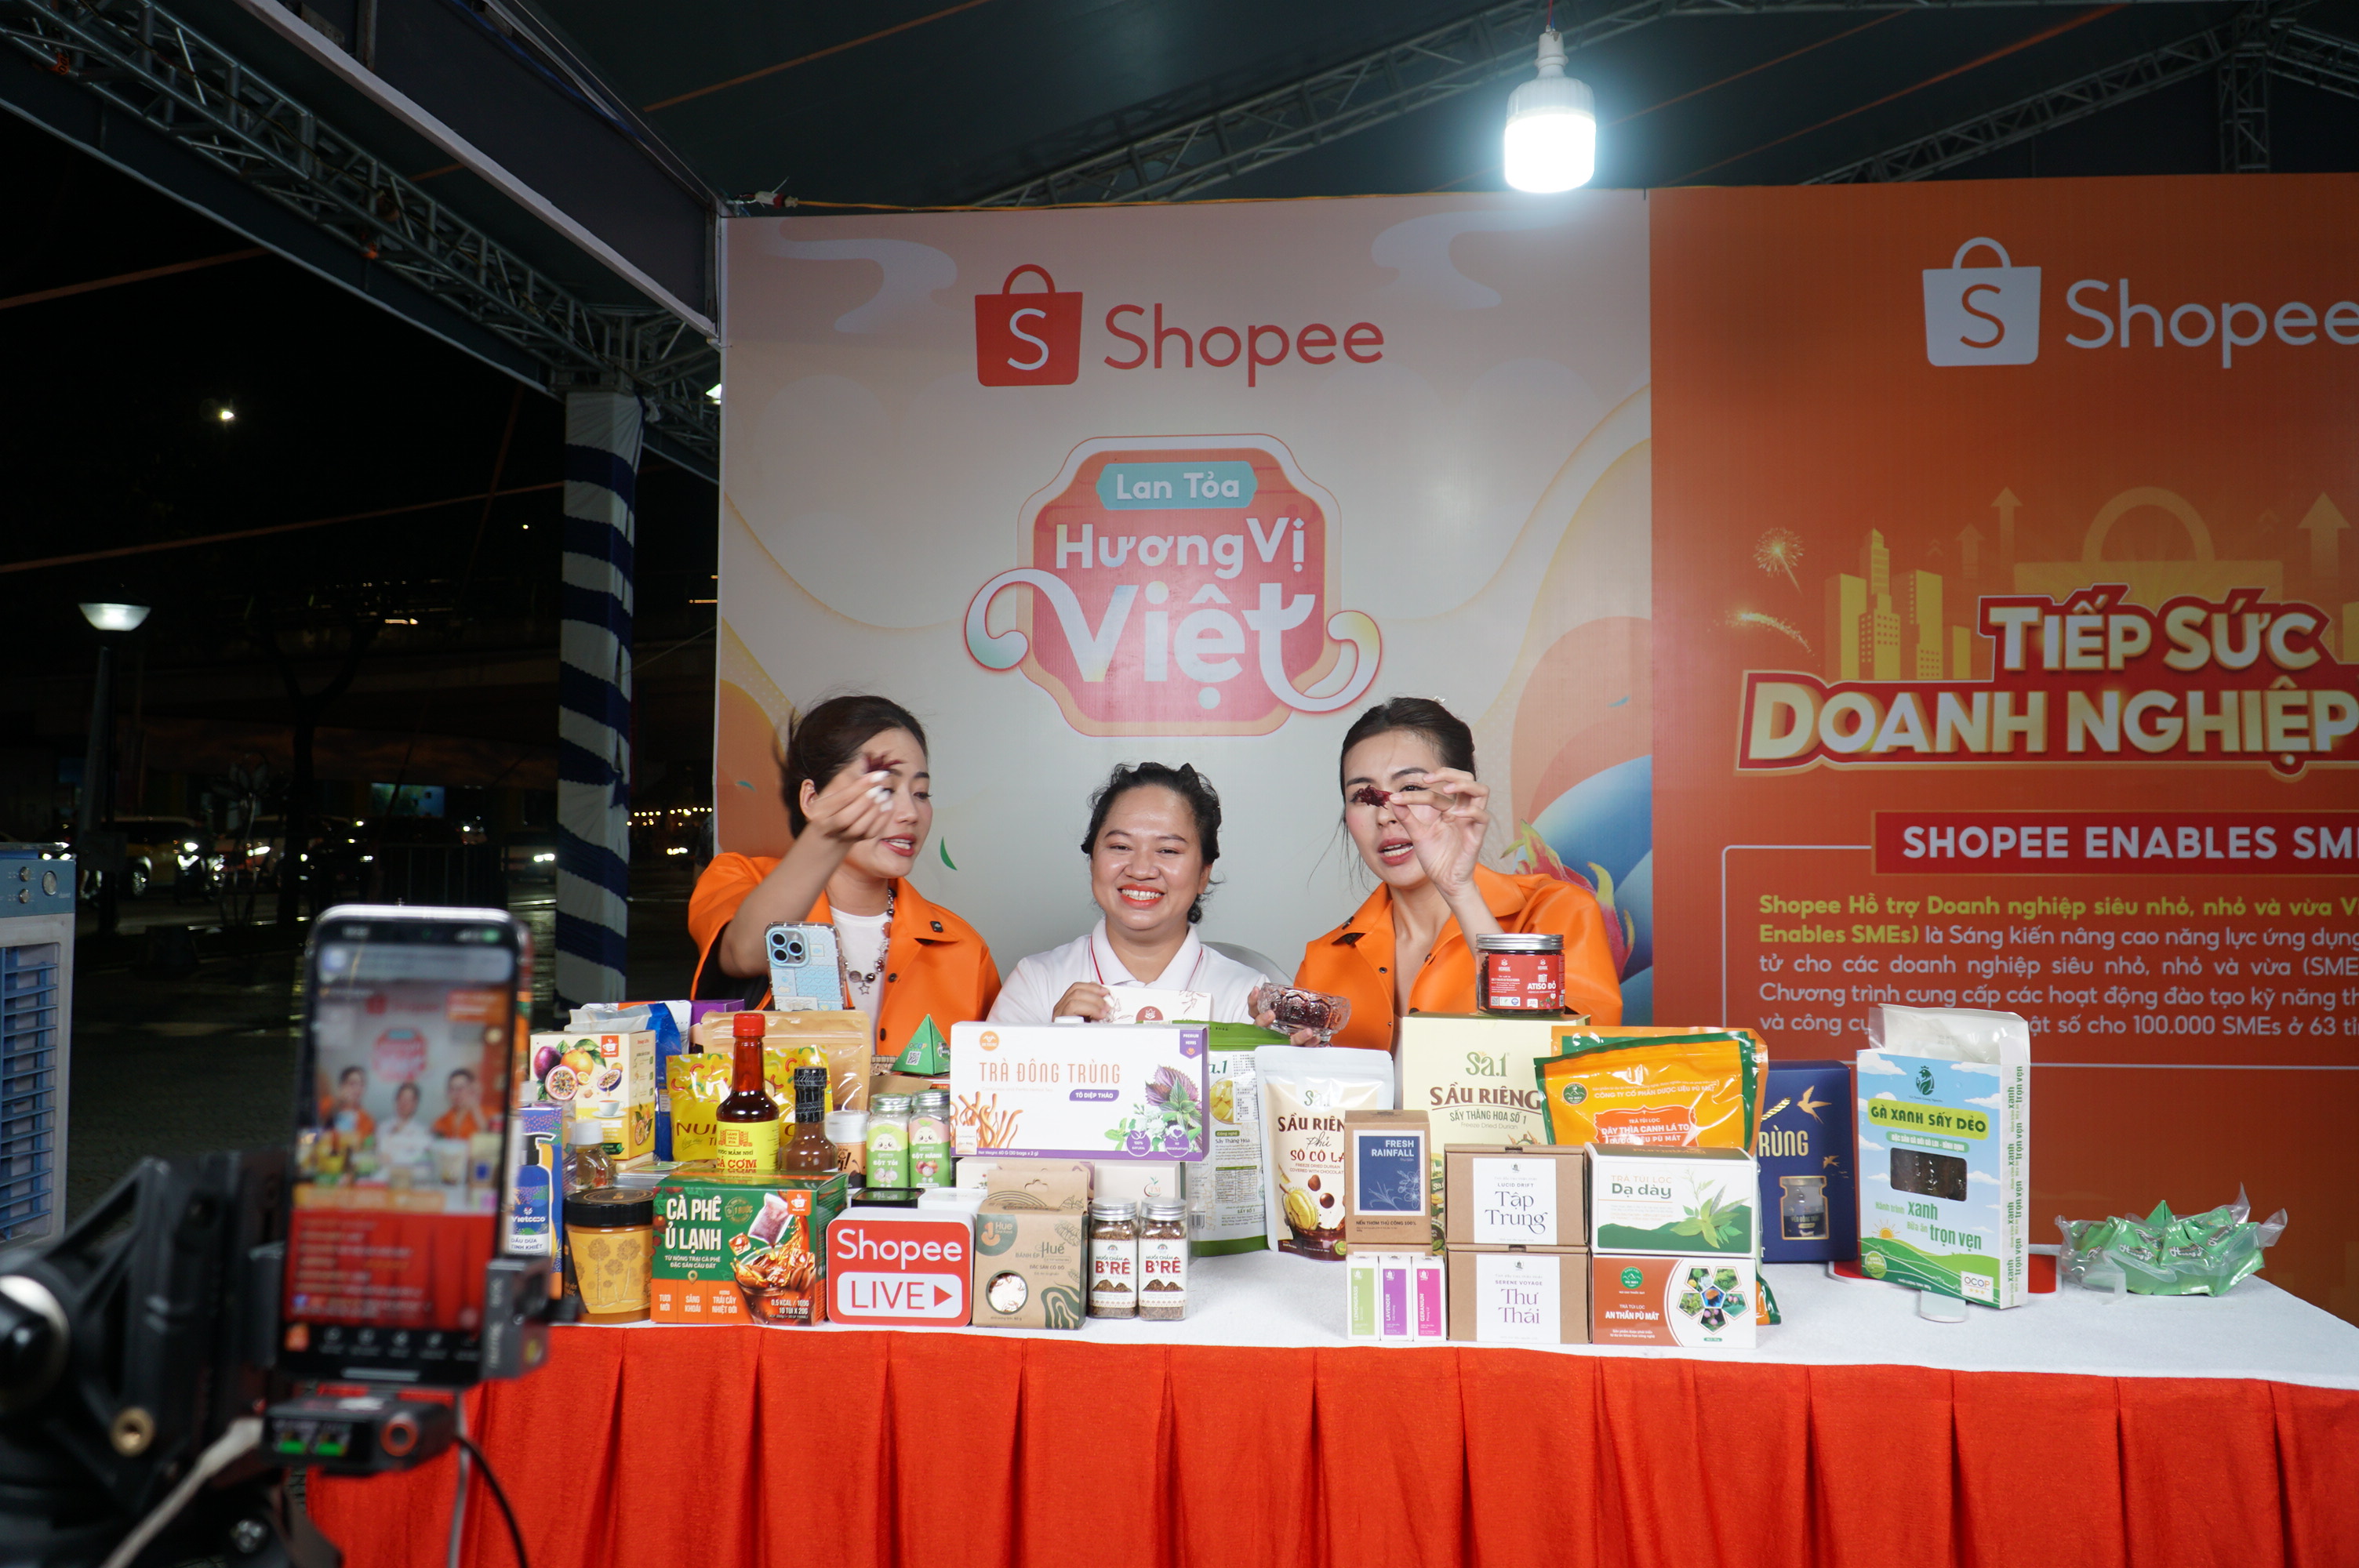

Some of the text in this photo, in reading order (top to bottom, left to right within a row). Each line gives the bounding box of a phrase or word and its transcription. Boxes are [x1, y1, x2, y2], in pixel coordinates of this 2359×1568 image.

[2066, 278, 2359, 369] Shopee
[1104, 303, 1384, 387] Shopee
[1116, 471, 1240, 501] Lan Tỏa
[1056, 517, 1304, 579] Hương Vị
[965, 568, 1382, 713] Việt
[1988, 594, 2321, 670] TIẾP SỨC
[1749, 677, 2359, 767] DOANH NGHIỆP
[1903, 826, 2069, 860] SHOPEE
[2085, 826, 2278, 860] ENABLES
[1760, 895, 1841, 919] Shopee
[1886, 897, 1920, 918] trợ
[1928, 896, 2000, 915] Doanh
[2008, 896, 2086, 920] nghiệp
[2094, 897, 2138, 916] siêu
[2146, 896, 2194, 917] nhỏ,
[2204, 896, 2246, 916] nhỏ
[2254, 898, 2281, 916] và
[2289, 898, 2332, 916] vừa
[1759, 924, 1846, 944] Enables
[1852, 924, 1919, 945] SMEs)
[1925, 925, 1943, 944] là
[1949, 925, 2003, 950] Sáng
[2010, 925, 2054, 945] kiến
[2061, 927, 2115, 950] nâng
[2121, 931, 2159, 946] cao
[2165, 928, 2219, 952] năng
[2226, 927, 2257, 949] lực
[2263, 927, 2306, 952] ứng
[1759, 954, 1783, 973] tử
[1794, 955, 1832, 973] cho
[1842, 956, 1879, 973] các
[1889, 955, 1957, 974] doanh
[1968, 955, 2041, 979] nghiệp
[2052, 956, 2094, 975] siêu
[2105, 955, 2150, 976] nhỏ,
[2162, 956, 2202, 975] nhỏ
[2214, 958, 2239, 975] và
[2251, 958, 2292, 975] vừa
[1759, 982, 1845, 1007] Chương
[1852, 983, 1900, 1004] trình
[1906, 990, 1957, 1007] cung
[1962, 985, 2001, 1008] cấp
[2006, 985, 2043, 1004] các
[2048, 985, 2098, 1007] hoạt
[2103, 985, 2157, 1010] động
[2164, 986, 2204, 1005] đào
[2210, 989, 2245, 1008] tạo
[2251, 986, 2276, 1011] kỹ
[2281, 988, 2336, 1011] năng
[1760, 1014, 1784, 1031] và
[1790, 1015, 1841, 1036] công
[2058, 1014, 2081, 1033] số
[2088, 1015, 2126, 1034] cho
[2133, 1015, 2215, 1035] 100.000
[2223, 1016, 2281, 1036] SMEs
[2288, 1016, 2303, 1036] ở
[2310, 1016, 2336, 1036] 63
[980, 1058, 1120, 1083] TRÀ ĐÔNG TRÙNG
[1430, 1082, 1541, 1109] SẦU RIÊNG
[1278, 1113, 1346, 1133] SẦU RIÊN
[1450, 1110, 1464, 1122] SẤY
[1467, 1109, 1491, 1120] THĂNG
[1493, 1112, 1508, 1121] HOA
[1510, 1112, 1521, 1123] SỐ
[1666, 1123, 1678, 1131] LÁ
[1871, 1105, 1986, 1133] GÀ XANH SẤY DẺO
[728, 1159, 757, 1169] CƠM
[1290, 1149, 1305, 1162] SÔ
[1310, 1149, 1326, 1162] CÔ
[1372, 1149, 1414, 1157] RAINFALL
[1495, 1191, 1534, 1211] Tập
[1612, 1183, 1671, 1200] Dạ dày
[667, 1194, 722, 1221] CÀ PHÊ
[1876, 1201, 1890, 1212] Hành
[1908, 1201, 1938, 1221] xanh
[1485, 1210, 1548, 1234] Trung
[666, 1221, 722, 1254] Ủ LẠNH
[1907, 1221, 1982, 1251] Bữa ăn trọn vẹn
[837, 1229, 962, 1270] Shopee
[1965, 1276, 1990, 1287] OCOP
[852, 1281, 925, 1309] LIVE
[1501, 1288, 1539, 1305] Thư
[1499, 1307, 1540, 1324] Thái
[1616, 1310, 1634, 1319] THẦN
[1635, 1311, 1644, 1320] PÙ
[1645, 1311, 1659, 1321] MÁT
